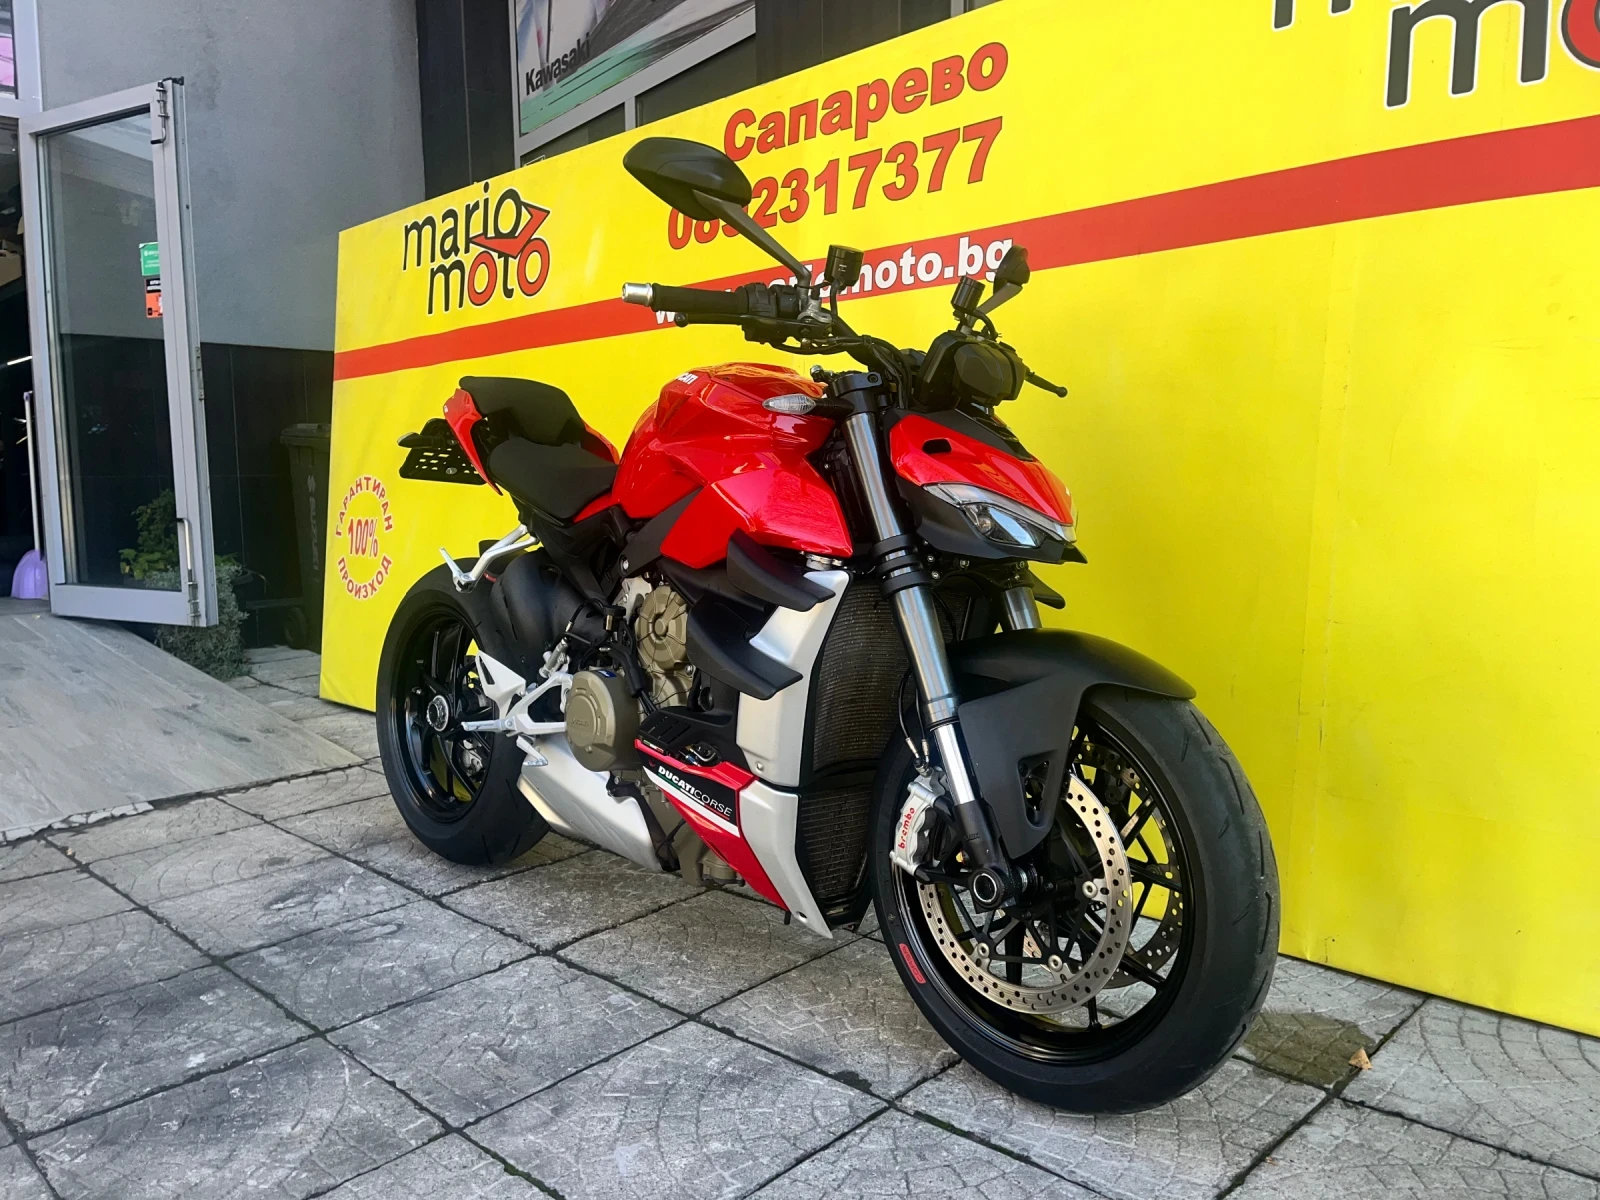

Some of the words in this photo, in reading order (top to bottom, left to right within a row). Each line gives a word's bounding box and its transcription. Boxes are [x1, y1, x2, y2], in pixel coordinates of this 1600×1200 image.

[525, 31, 590, 96] Kawasaki
[723, 41, 1009, 162] Сапарево
[667, 116, 1003, 250] 02317377
[402, 181, 522, 271] mario
[427, 238, 551, 315] moto
[335, 476, 393, 536] ГАРАНТИРАН
[347, 518, 379, 558] 100%
[337, 555, 393, 600] ПРОИЗХОД
[898, 807, 915, 849] brembo
